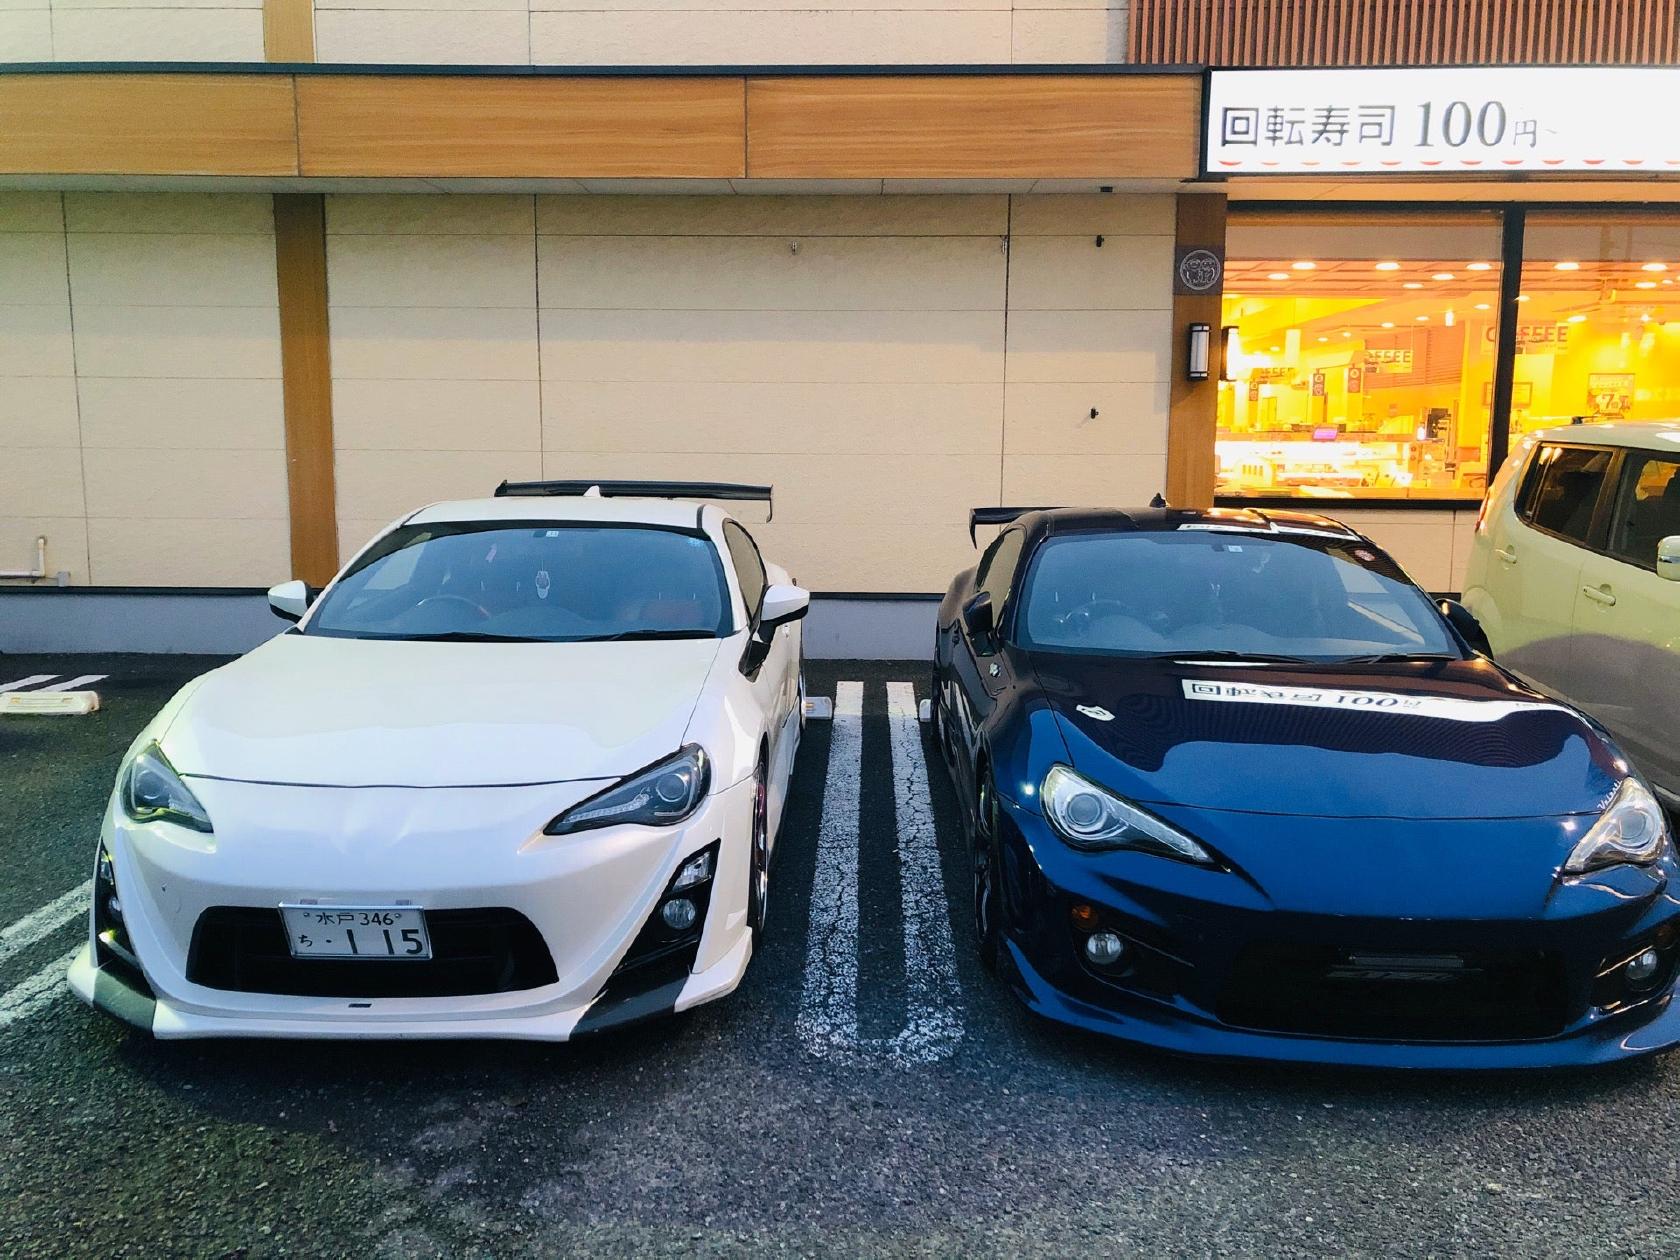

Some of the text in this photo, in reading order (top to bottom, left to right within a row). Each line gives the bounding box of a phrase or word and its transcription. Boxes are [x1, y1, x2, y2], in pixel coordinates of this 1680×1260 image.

[1221, 104, 1396, 147] 回転寿司
[316, 912, 394, 926] 水戸 346
[298, 934, 313, 947] ち
